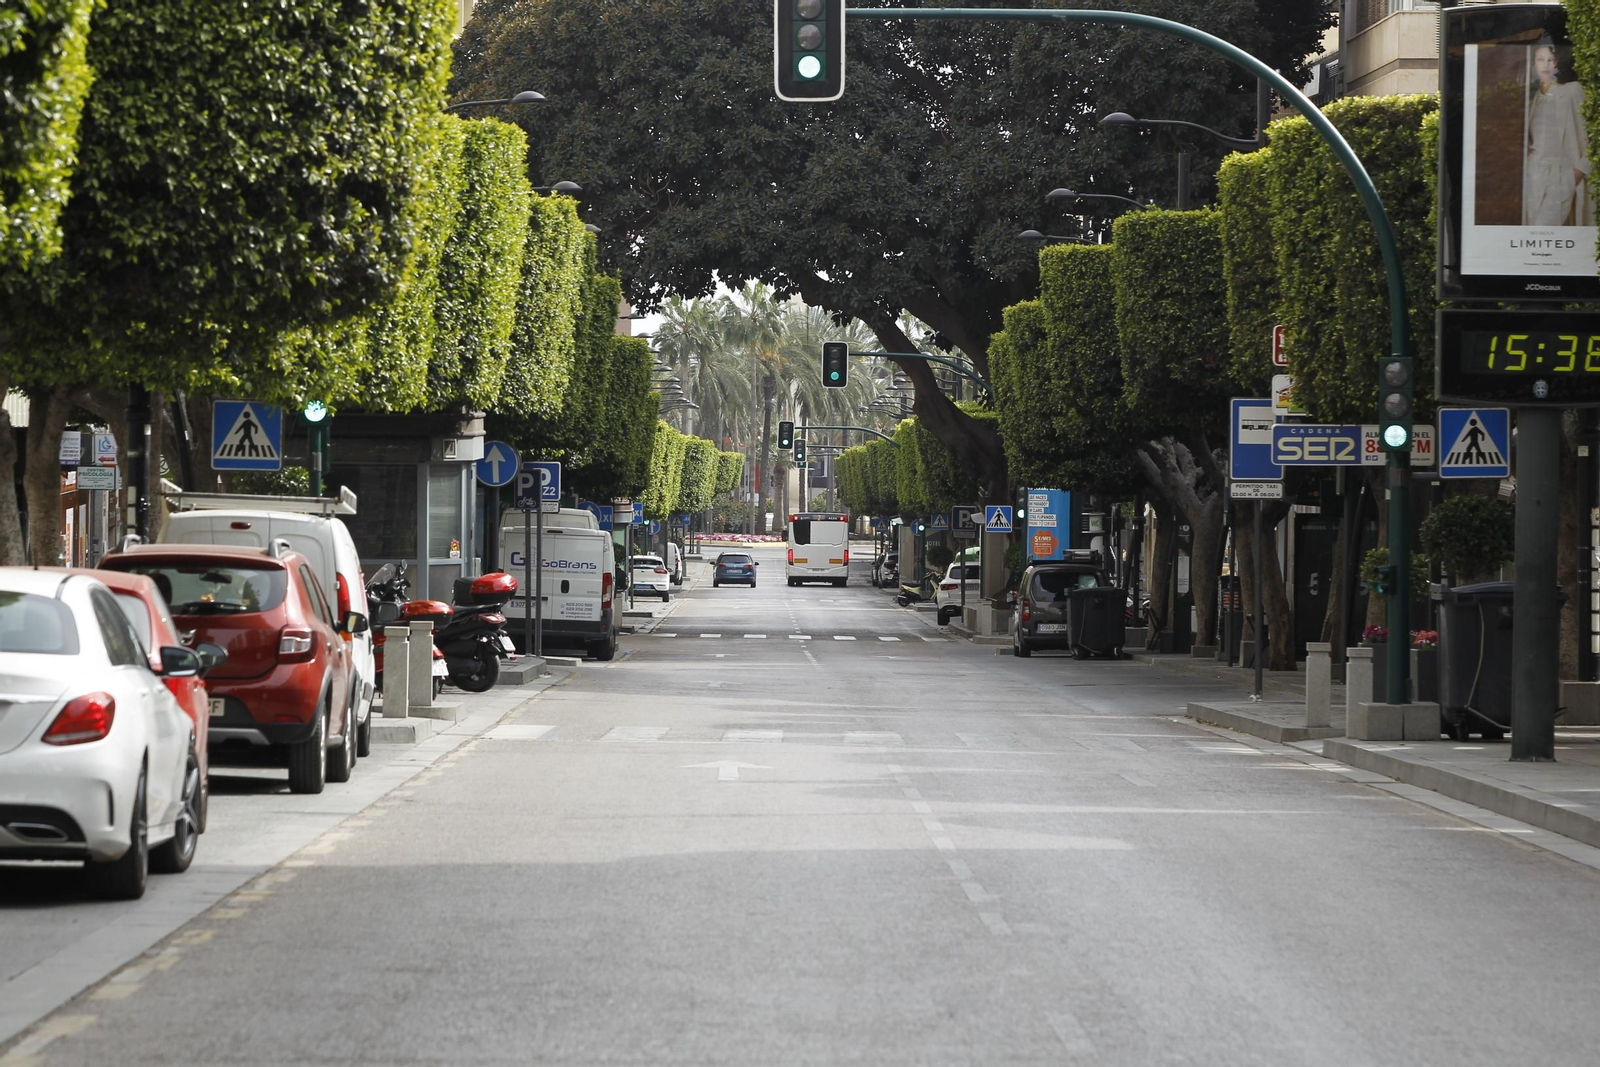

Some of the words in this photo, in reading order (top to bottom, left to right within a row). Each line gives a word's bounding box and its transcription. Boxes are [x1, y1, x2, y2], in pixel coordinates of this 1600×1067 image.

[1510, 239, 1575, 249] LIMITED
[1525, 283, 1562, 291] JCDecaux
[1277, 437, 1356, 461] SER
[517, 472, 535, 497] P
[959, 510, 972, 528] P
[541, 559, 597, 571] GoBrans
